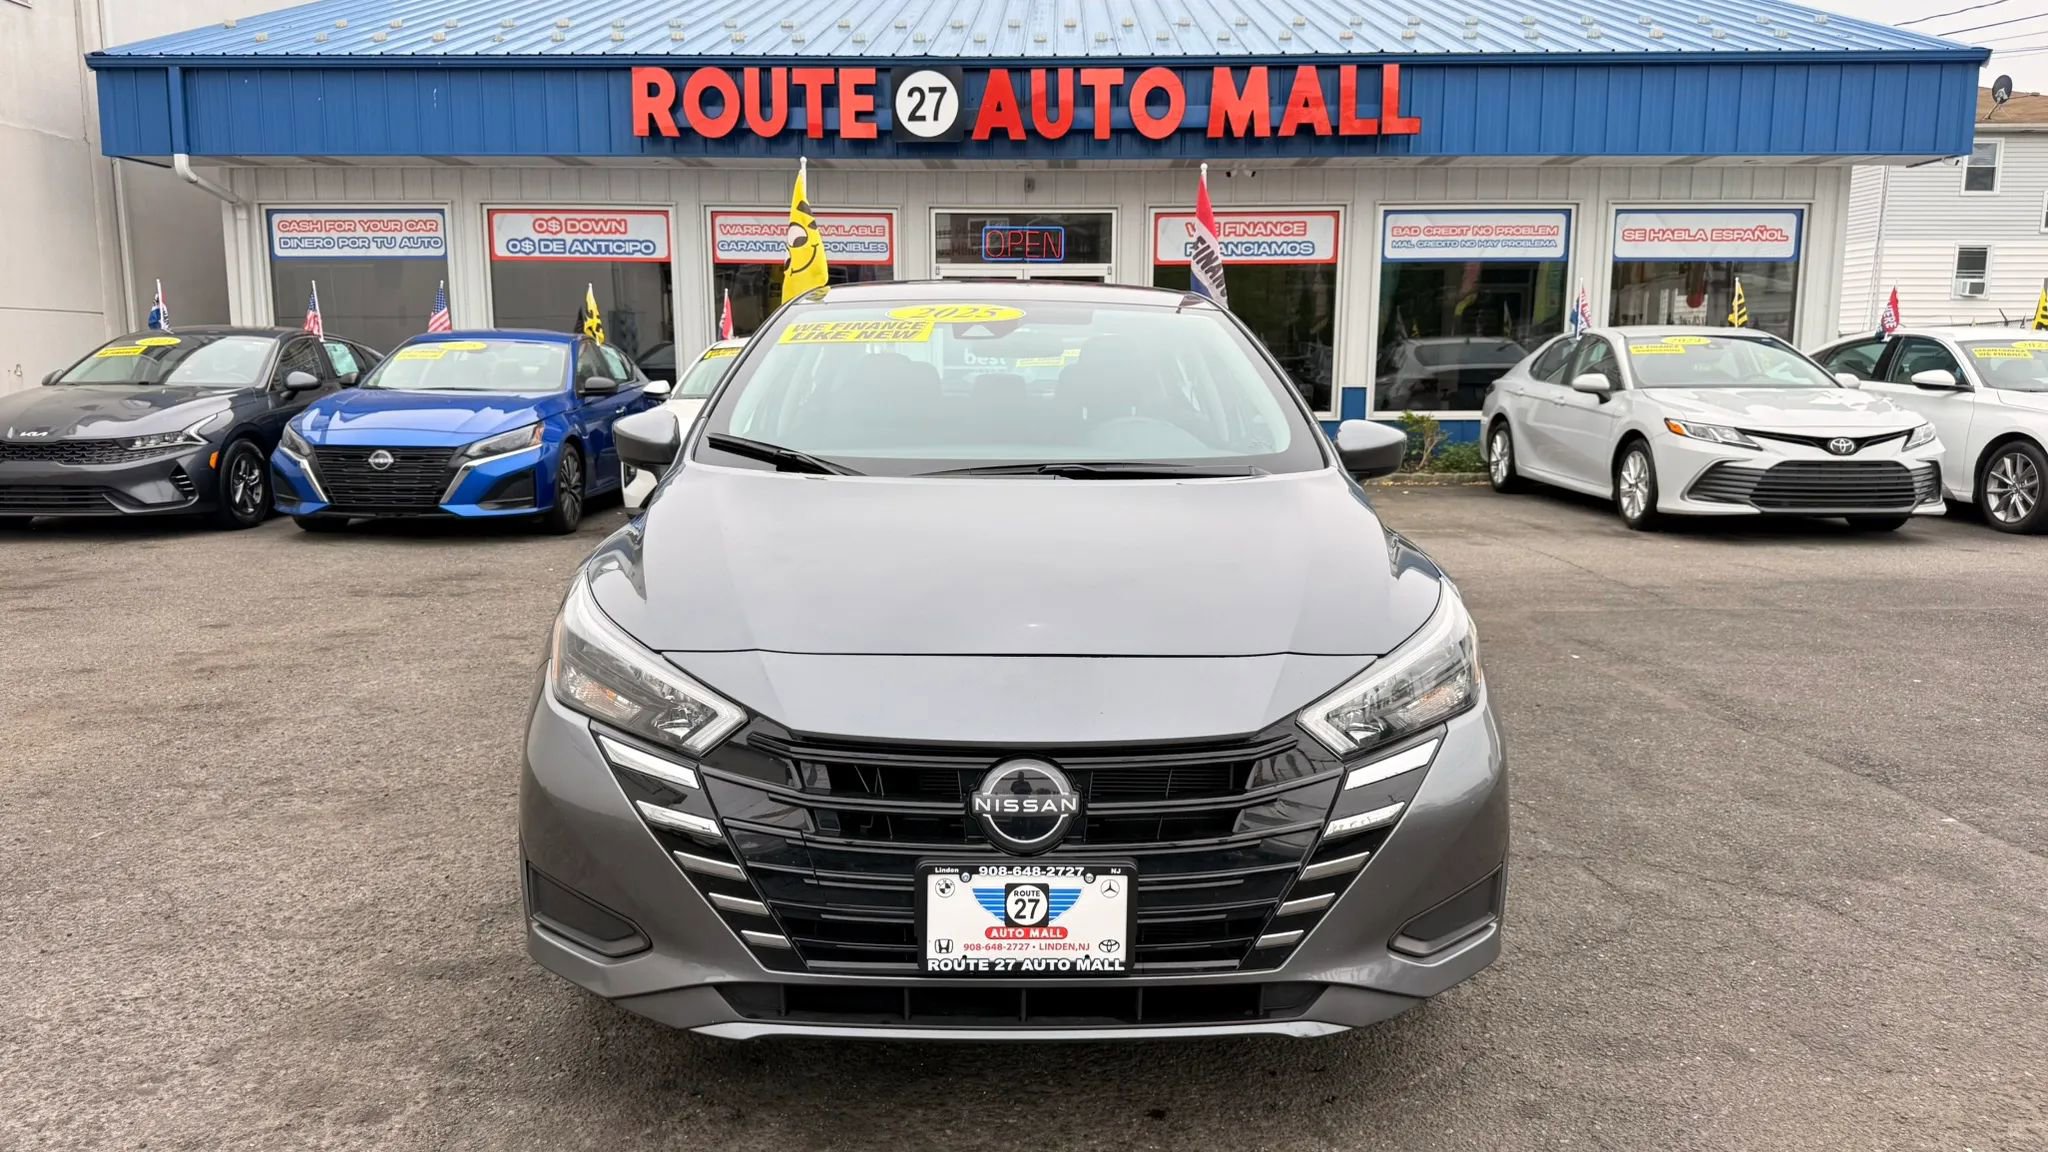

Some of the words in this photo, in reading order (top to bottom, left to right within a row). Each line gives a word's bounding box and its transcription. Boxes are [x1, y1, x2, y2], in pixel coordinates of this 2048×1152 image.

[631, 66, 878, 139] ROUTE
[907, 86, 947, 122] 27
[971, 67, 1187, 140] AUTO
[1206, 63, 1422, 138] MALL
[278, 219, 322, 233] CASH
[325, 219, 356, 233] FOR
[359, 219, 401, 233] YOUR
[404, 220, 438, 233] CAR
[566, 218, 627, 235] DOWN
[719, 223, 788, 236] WARRANT
[1223, 221, 1307, 237] FINANCE
[1391, 225, 1421, 237] BAD
[1423, 225, 1470, 236] CREDIT
[1472, 225, 1493, 236] NO
[1495, 226, 1559, 236] PROBLEM
[1622, 228, 1647, 242] SE
[1648, 228, 1708, 242] HABLA
[1710, 226, 1789, 242] ESPAÑOL
[279, 236, 335, 249] DINERO
[337, 236, 370, 249] POR
[372, 237, 397, 249] TU
[399, 237, 443, 249] AUTO
[538, 238, 566, 253] DE
[568, 239, 656, 254] ANTICIPO
[718, 241, 787, 252] GARANTIA
[825, 241, 888, 253] PONIBLES
[985, 229, 1062, 258] OPEN
[1185, 241, 1315, 257] FANCIAMOS
[1391, 239, 1415, 249] MAL
[1416, 240, 1458, 249] CREDITO
[1460, 240, 1476, 249] NO
[1478, 240, 1500, 249] HAY
[1501, 240, 1557, 249] PROBLEMA
[910, 307, 998, 319] 2025
[793, 323, 825, 332] WE
[831, 320, 928, 331] FINANCE
[790, 331, 851, 341] LIKE
[855, 330, 919, 340] NEW
[974, 797, 1077, 813] NISSAN
[978, 866, 1085, 877] 908-648-2727
[1013, 889, 1041, 897] ROUTE
[1014, 898, 1040, 919] 27
[990, 927, 1025, 938] AUTO
[1029, 927, 1064, 938] MALL
[963, 943, 1030, 951] 908-648-2727
[1039, 943, 1090, 952] LINDEN,NJ
[927, 958, 989, 971] ROUTE
[995, 958, 1016, 971] 27
[1021, 958, 1071, 971] AUTO
[1076, 959, 1125, 971] MALL
